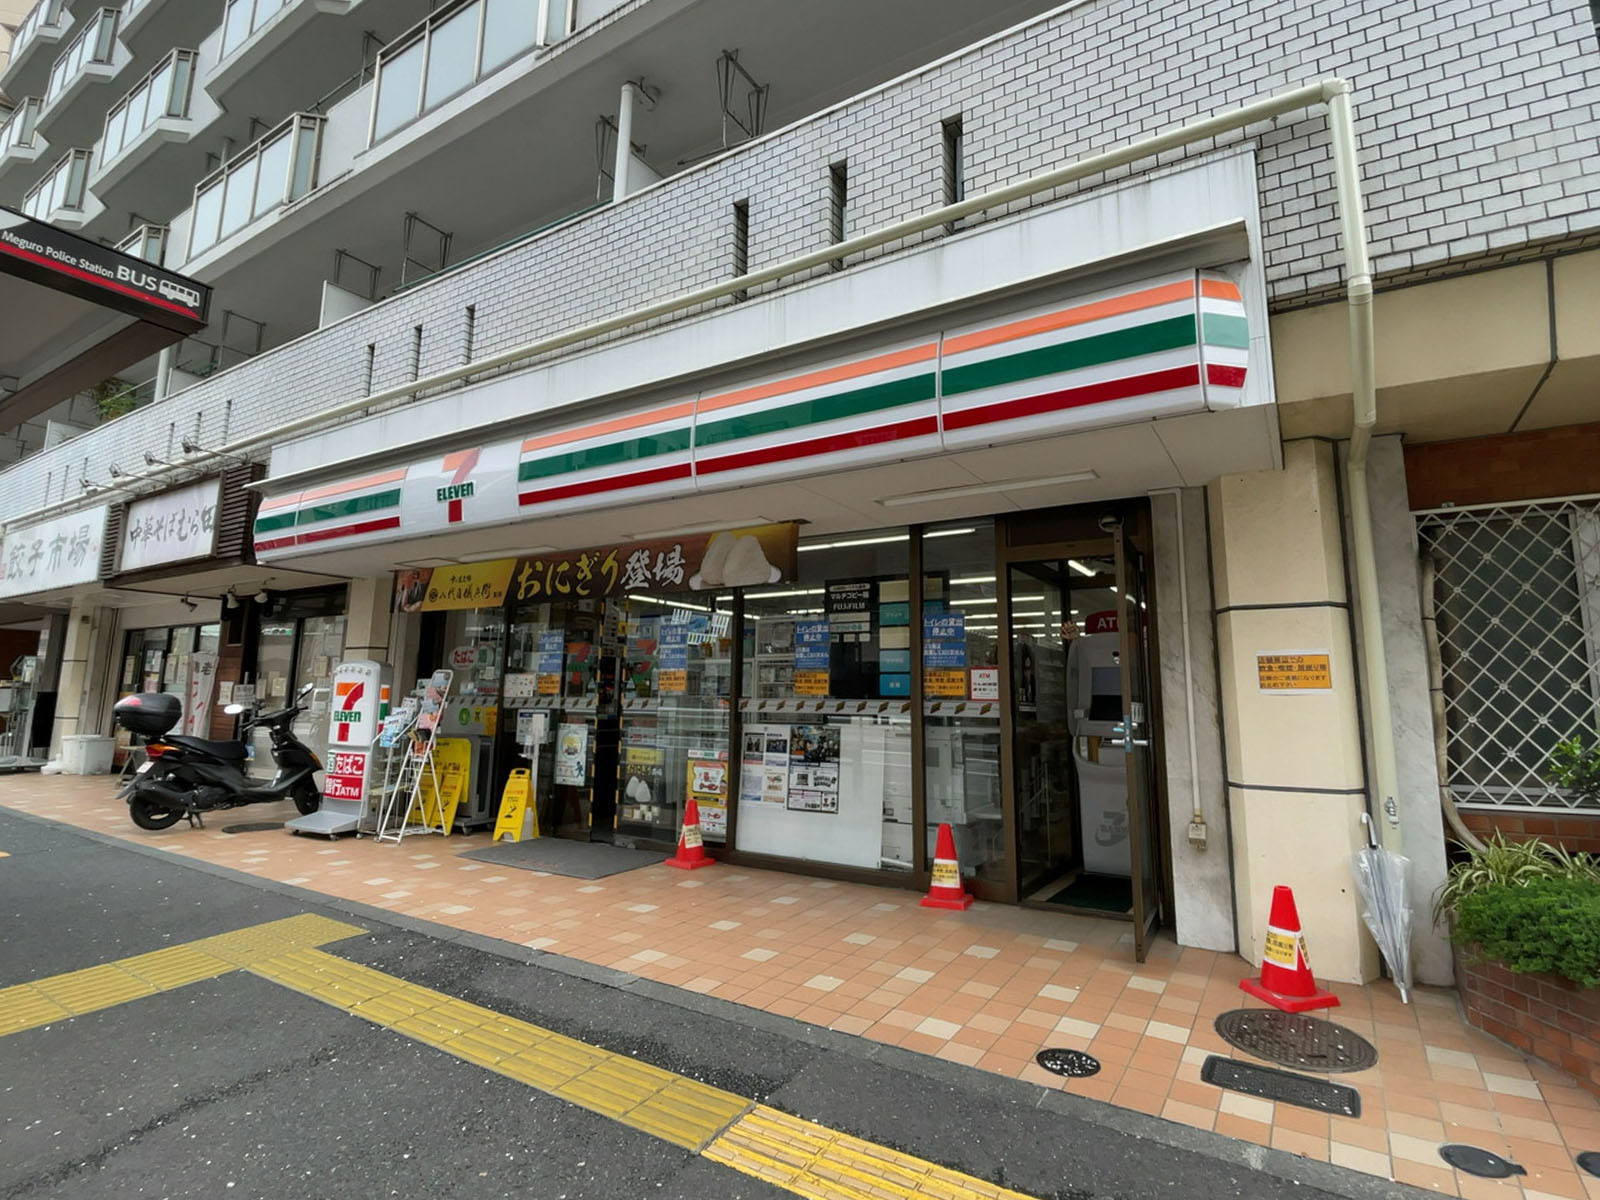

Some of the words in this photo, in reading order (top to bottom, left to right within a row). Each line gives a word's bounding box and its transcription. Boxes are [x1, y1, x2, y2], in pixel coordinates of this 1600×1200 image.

[1, 231, 43, 253] Meguro
[46, 246, 77, 266] Police
[79, 258, 114, 279] Station
[117, 264, 157, 291] BUS
[517, 544, 686, 600] おにぎり登場
[833, 602, 866, 610] FUJIFILM
[1097, 616, 1117, 630] AT
[336, 681, 365, 742] 7
[335, 755, 363, 775] たばこ
